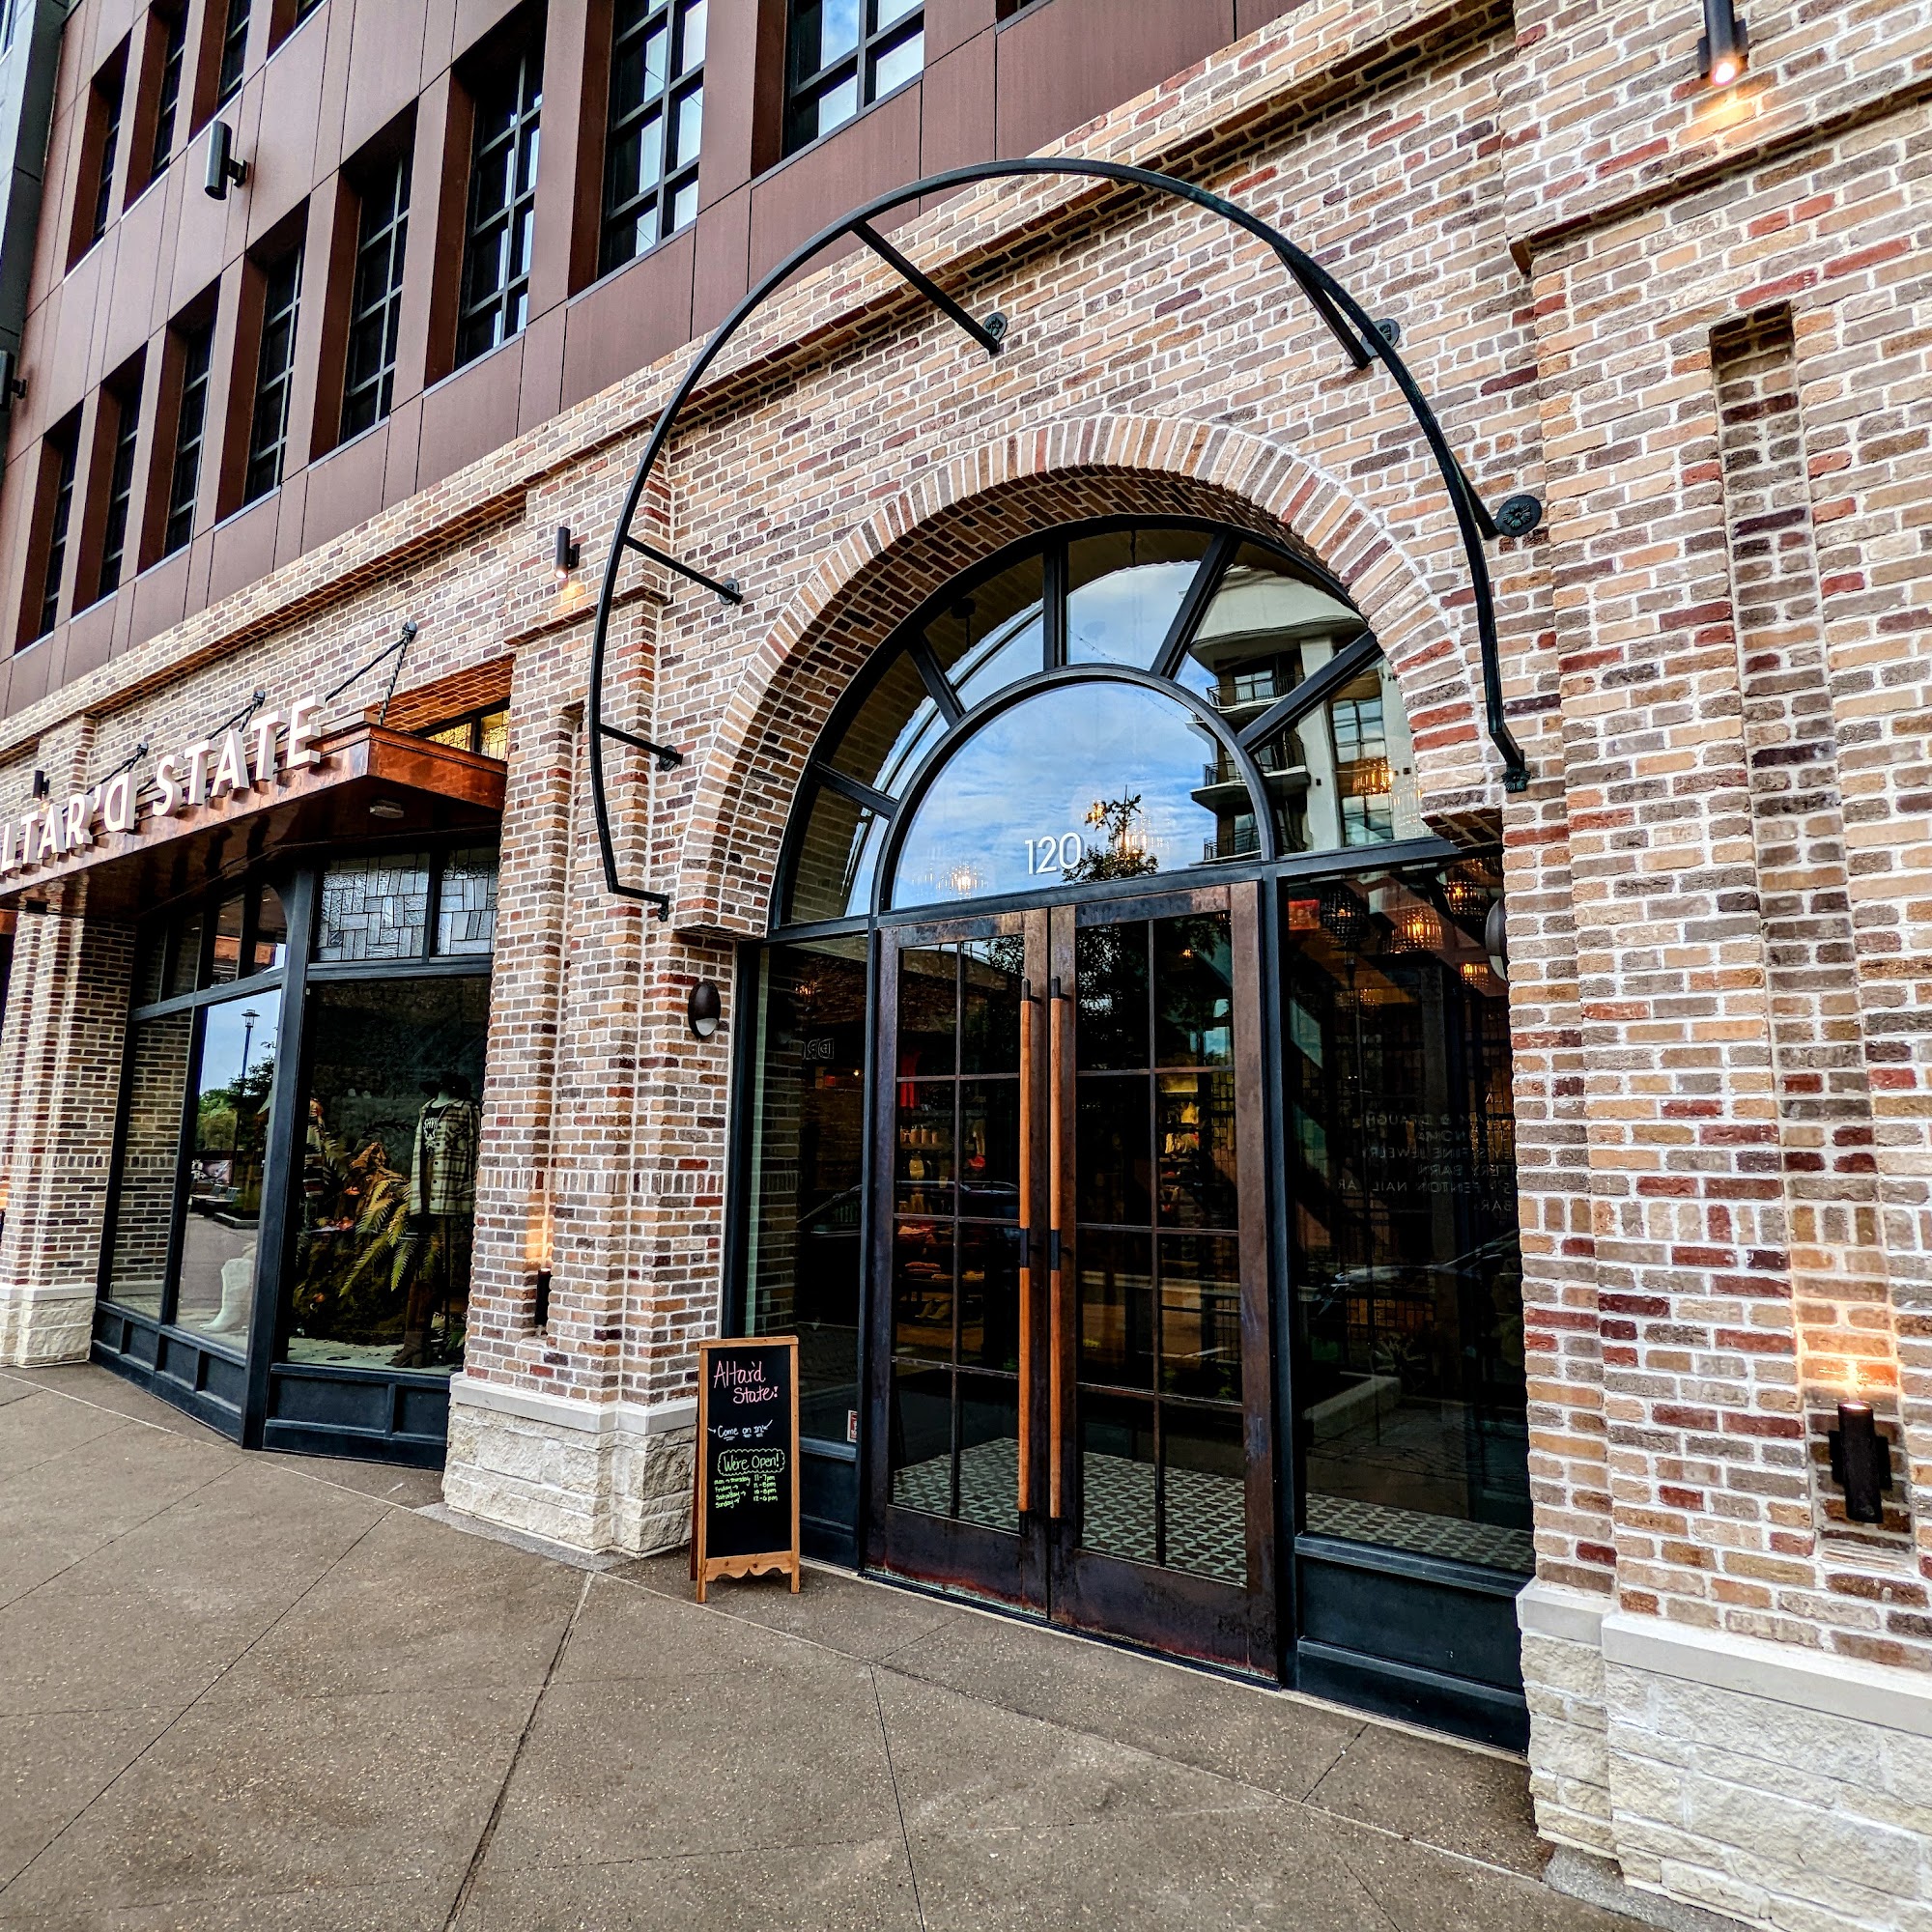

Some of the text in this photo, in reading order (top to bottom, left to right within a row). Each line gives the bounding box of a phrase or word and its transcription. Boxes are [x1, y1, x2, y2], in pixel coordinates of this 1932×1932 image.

[152, 694, 326, 817] STATE
[1025, 832, 1083, 875] 120
[733, 1385, 779, 1404] State!
[752, 1453, 780, 1469] Open!
